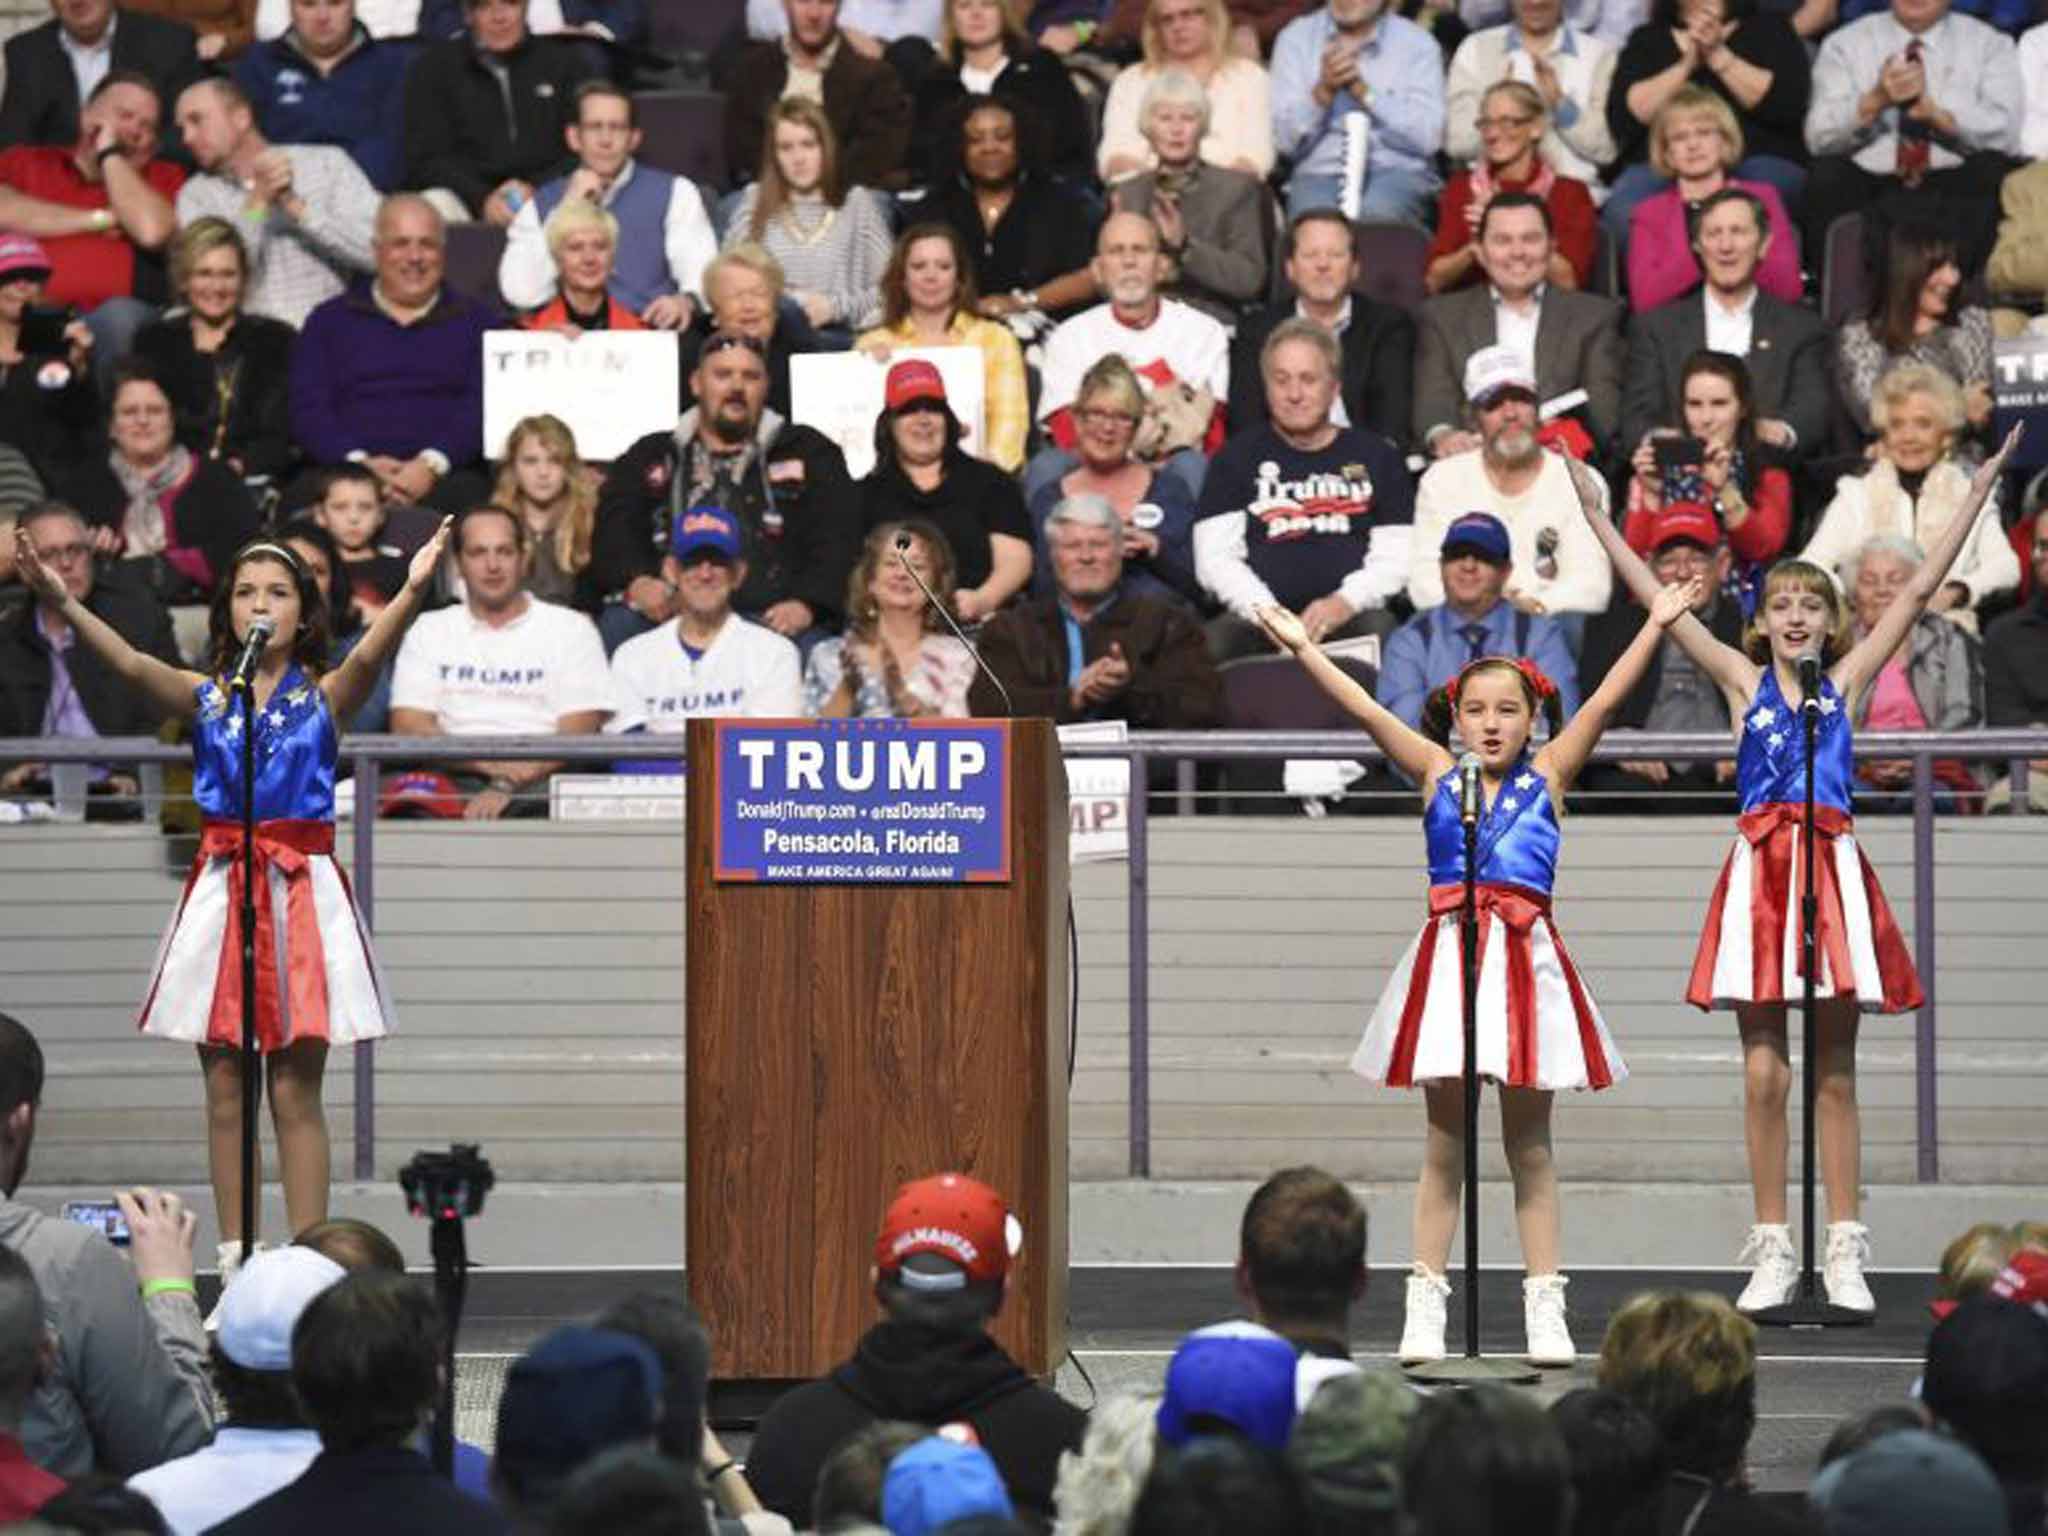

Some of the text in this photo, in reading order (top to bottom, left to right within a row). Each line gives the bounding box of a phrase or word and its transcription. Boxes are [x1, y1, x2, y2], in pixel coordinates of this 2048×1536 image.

[438, 663, 545, 686] TRUMP
[645, 686, 745, 712] TRUMP
[738, 740, 986, 791] TRUMP
[736, 800, 857, 822] DonaldJTrump.com
[763, 828, 960, 856] Pensacola, Florida
[767, 865, 803, 878] MAKE
[807, 865, 864, 878] AMERICA
[865, 865, 909, 878] GREAT
